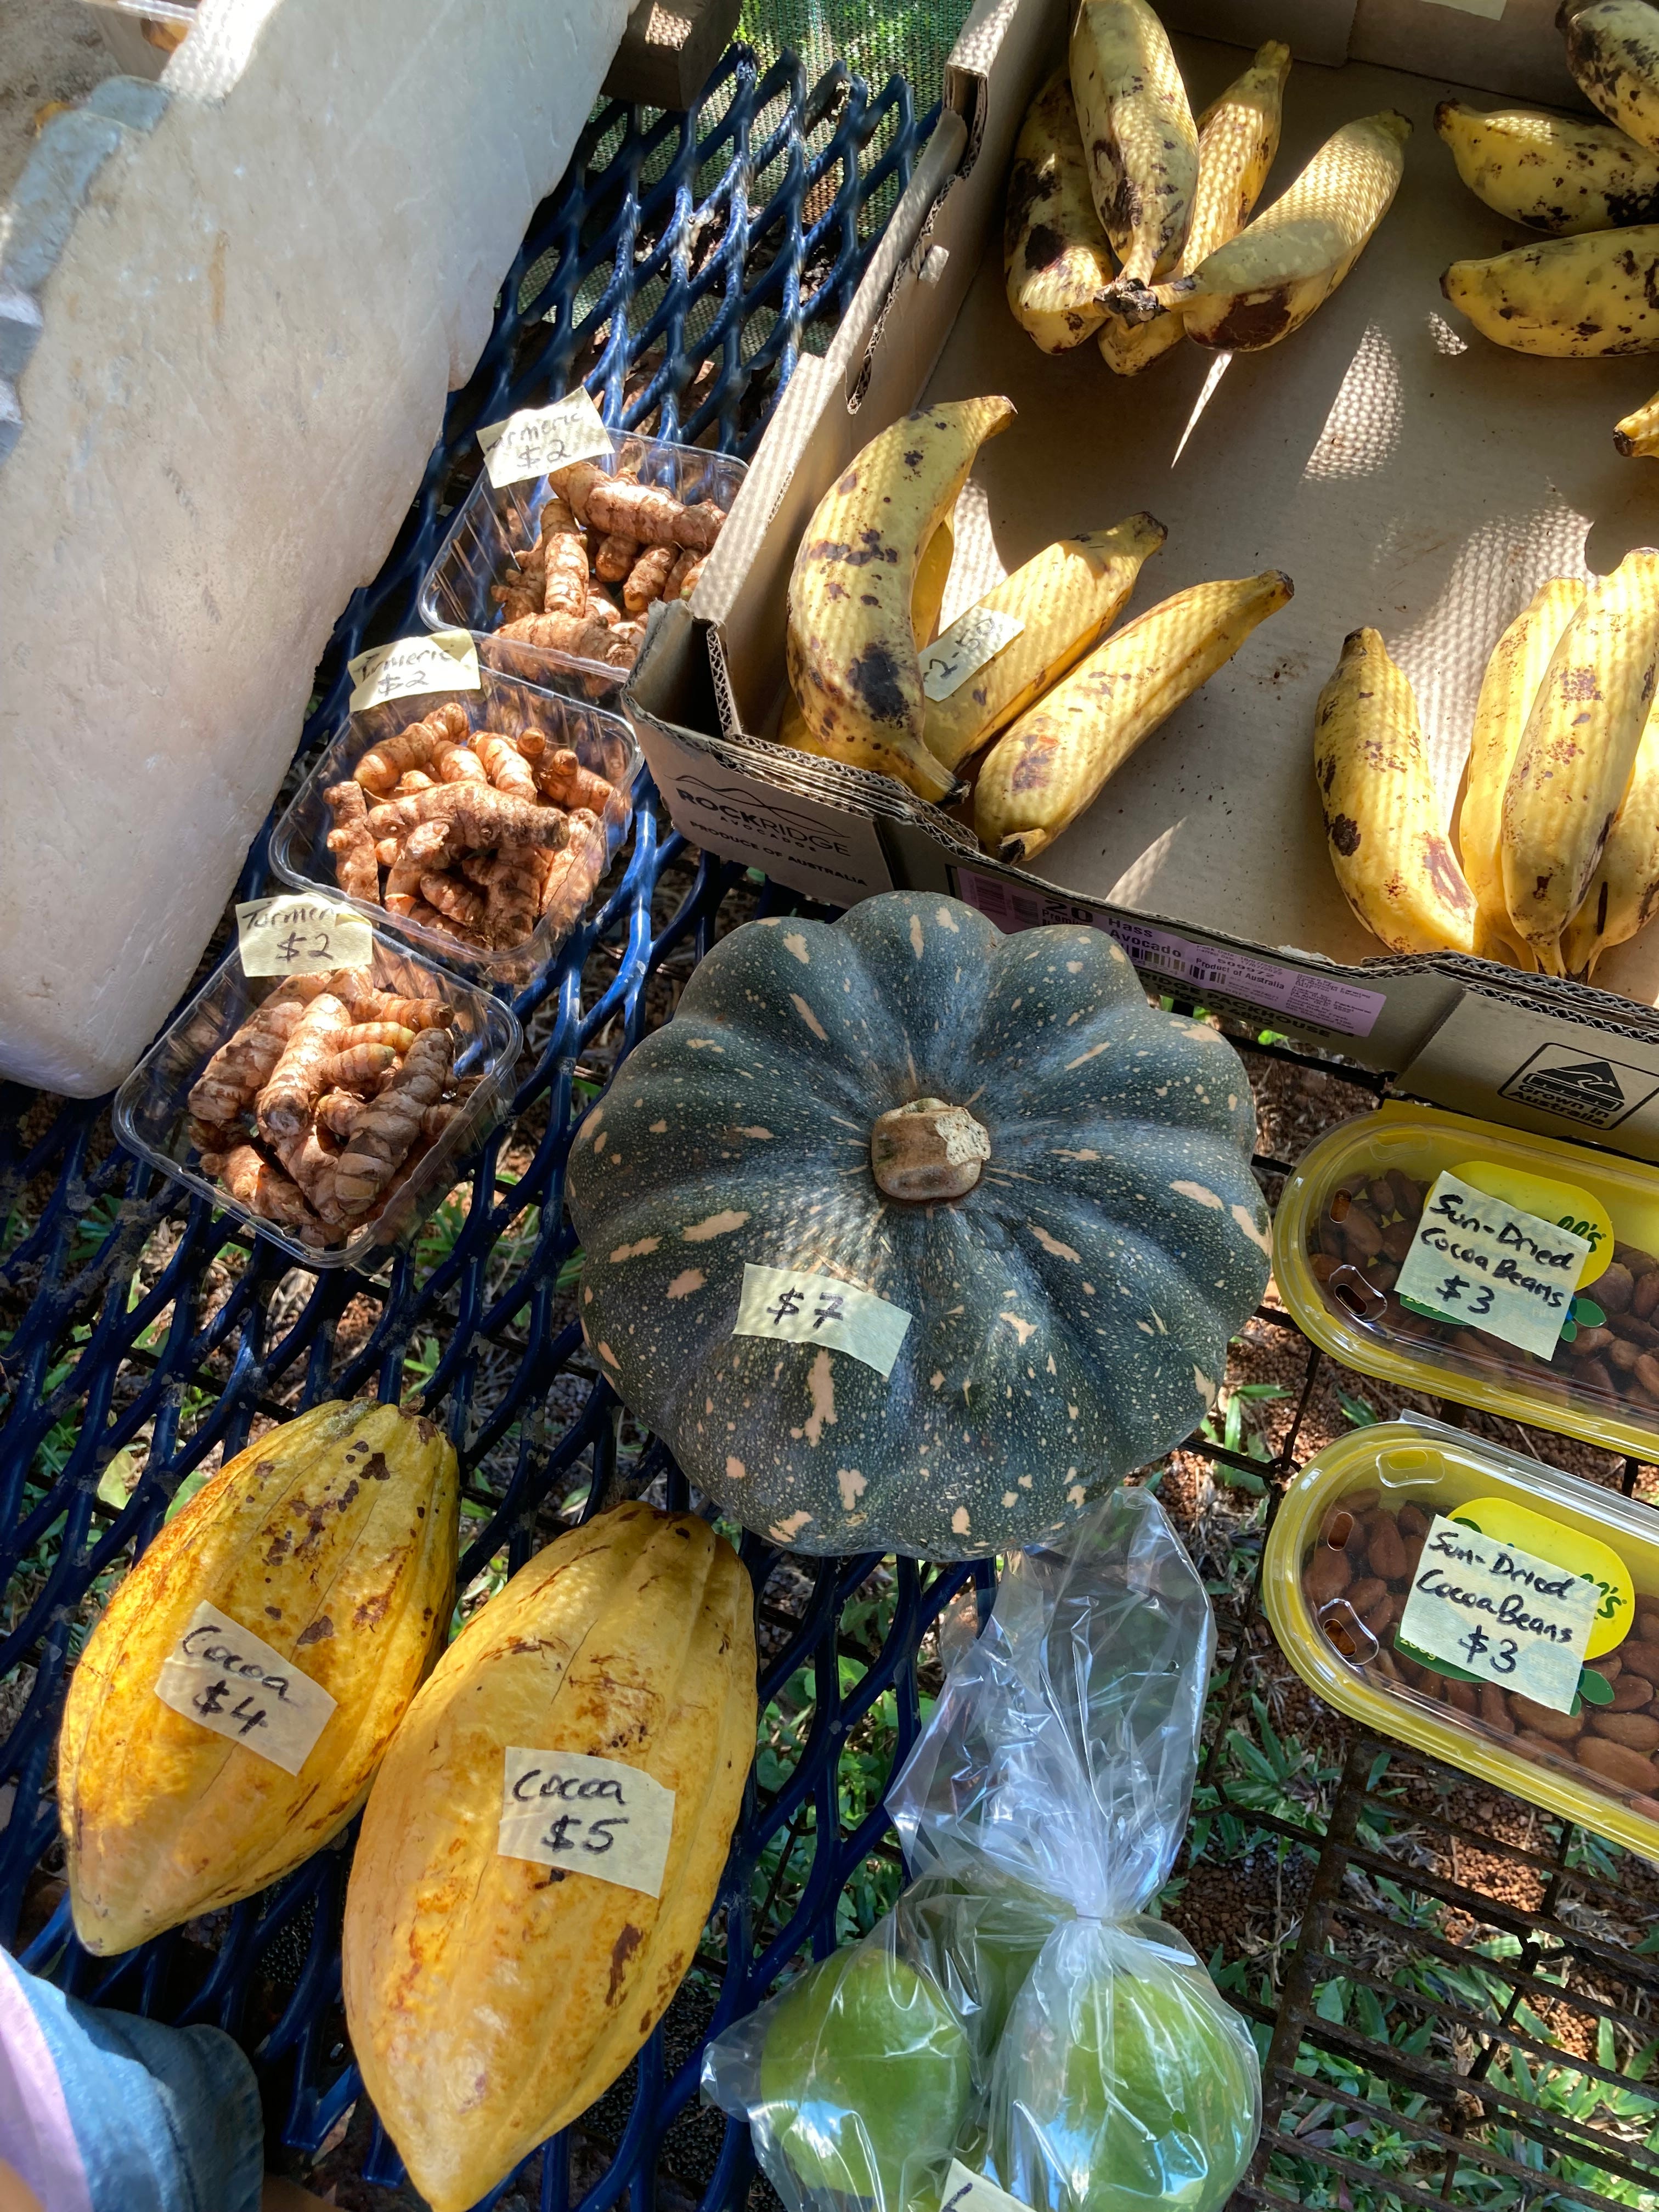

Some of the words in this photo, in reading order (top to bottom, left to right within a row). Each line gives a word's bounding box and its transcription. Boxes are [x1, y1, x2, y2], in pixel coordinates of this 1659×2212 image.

[517, 439, 572, 470] $2
[378, 670, 428, 697] $2
[676, 788, 851, 856] ROCKRIDGE
[720, 816, 817, 852] AVOCADOS
[690, 821, 760, 849] PRODUCE
[763, 848, 783, 857] OF
[788, 855, 868, 887] AUSTRALIA
[1044, 900, 1093, 923] 20
[1109, 918, 1153, 937] Hass
[275, 932, 334, 962] $2
[1110, 929, 1182, 957] Avocado
[1196, 958, 1229, 973] Product
[1245, 973, 1285, 989] Australia
[1136, 970, 1200, 995] RIDGE
[1207, 993, 1330, 1037] PACKHOUSE
[1154, 983, 1203, 1003] Tolga
[1208, 1001, 1224, 1010] Q
[1508, 1091, 1605, 1125] Australia
[1518, 1085, 1584, 1110] Grown
[1429, 1194, 1575, 1270] Sun-Dried
[1421, 1227, 1488, 1271] Cocoa
[1492, 1259, 1565, 1308] Beans
[766, 1285, 844, 1329] $7
[1435, 1275, 1496, 1314] $3
[1428, 1531, 1575, 1600] Sun-Dried
[183, 1625, 300, 1707] Cocoa
[1458, 1624, 1519, 1674] $3
[193, 1679, 269, 1736] $4
[512, 1769, 627, 1805] Cocoa
[541, 1814, 630, 1855] $5
